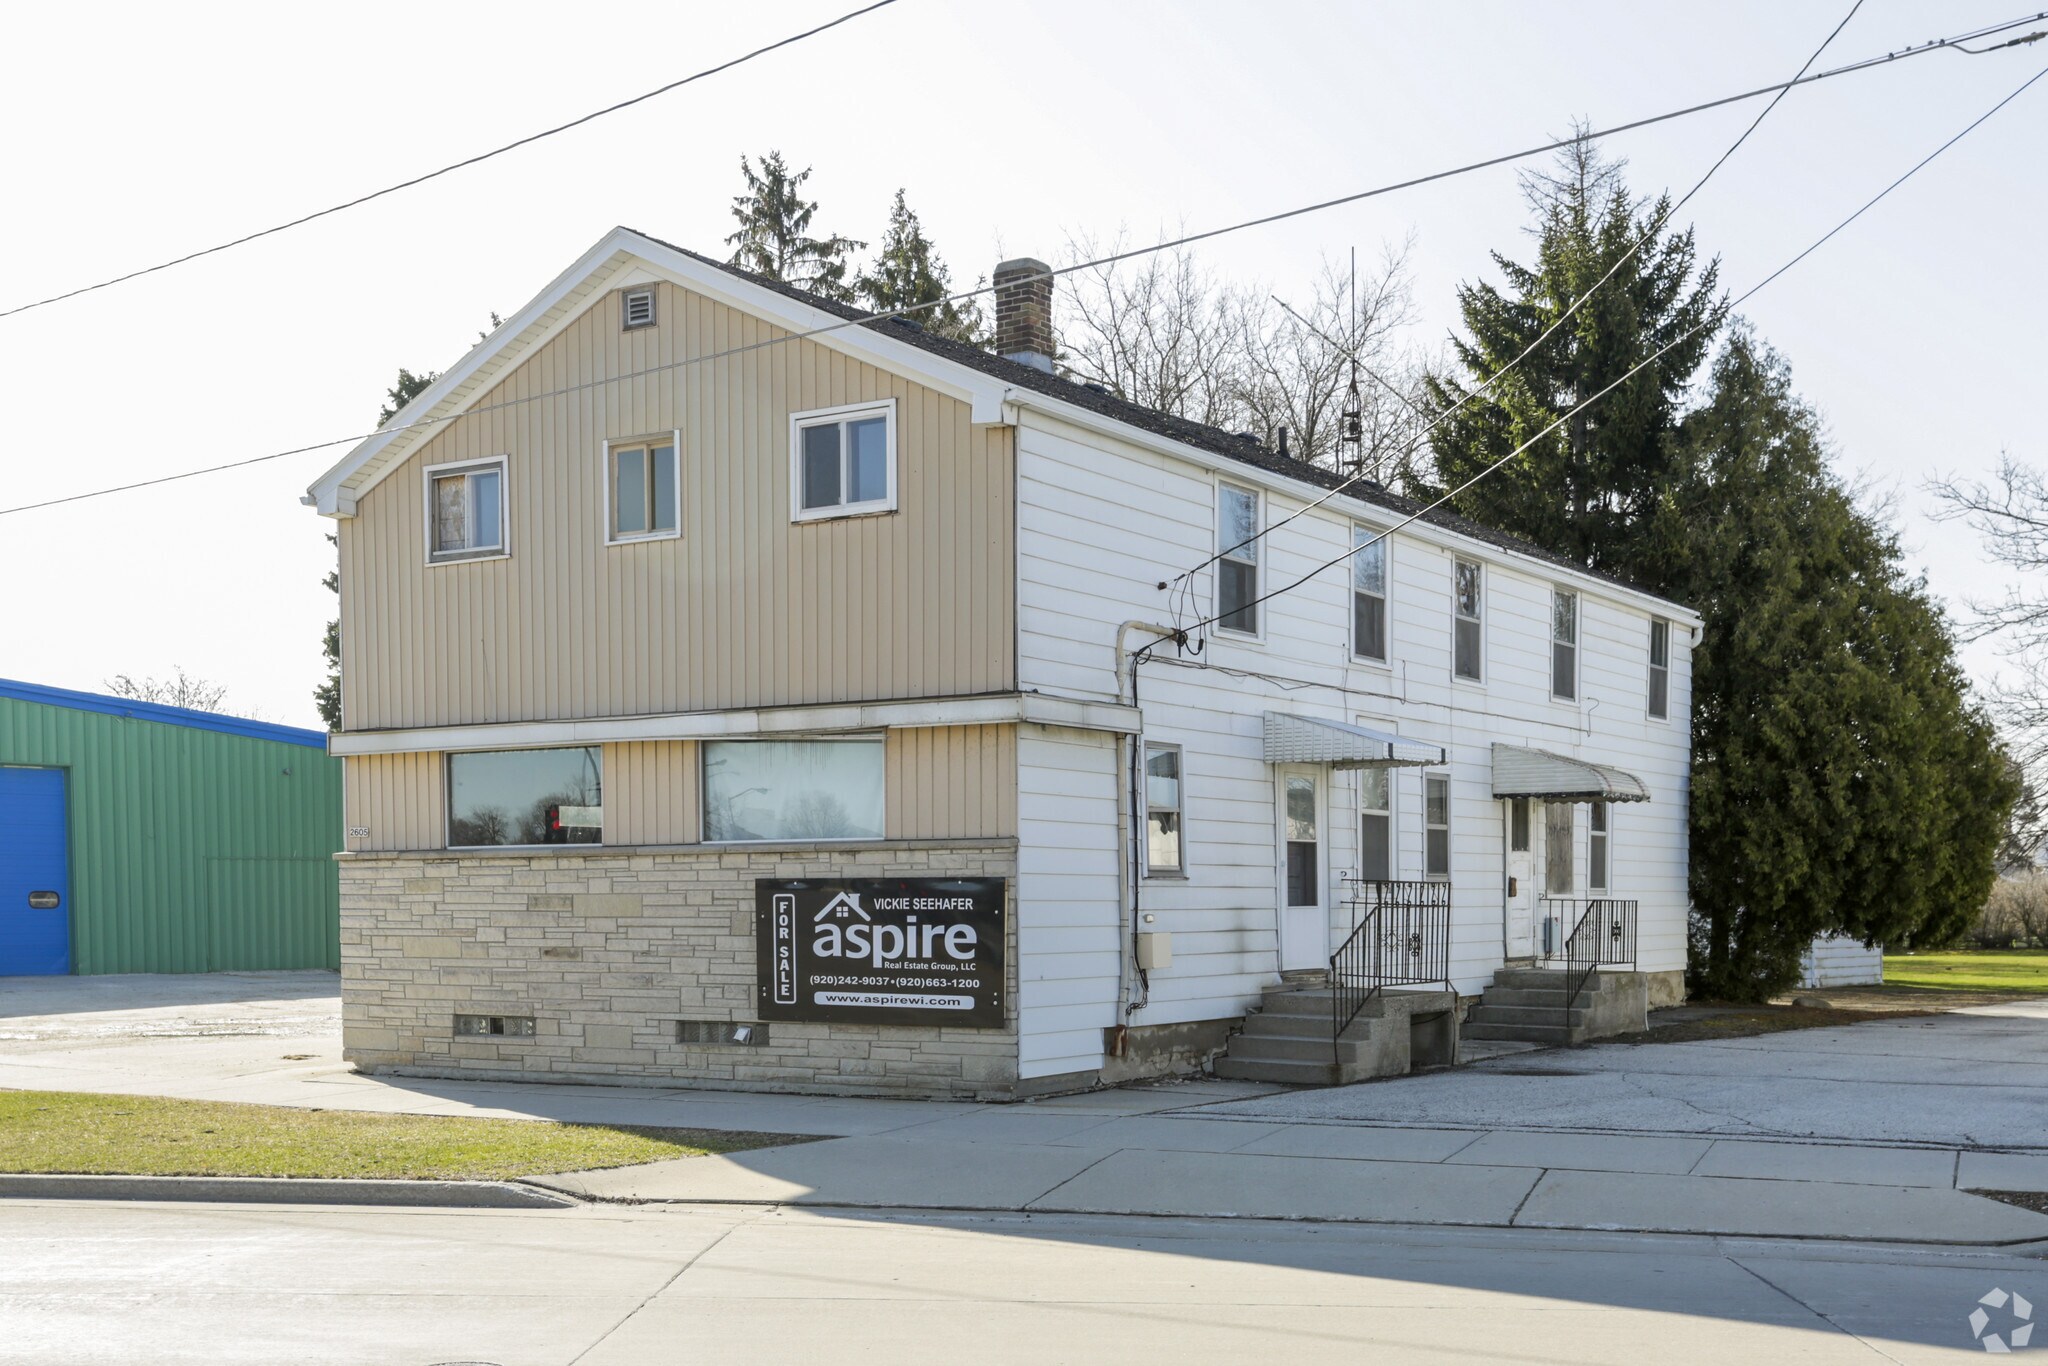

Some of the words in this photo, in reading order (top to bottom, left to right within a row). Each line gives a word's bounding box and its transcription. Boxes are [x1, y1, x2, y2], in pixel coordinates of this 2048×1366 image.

[350, 828, 368, 836] 2605
[874, 898, 910, 909] VICKIE
[913, 898, 973, 910] SEEHAFER
[779, 901, 789, 939] FOR
[812, 915, 977, 969] aspire
[779, 946, 789, 996] SALE
[885, 961, 902, 969] Real
[904, 962, 929, 970] Estate
[931, 962, 959, 972] Group,
[826, 995, 961, 1006] www.aspirewi.com
